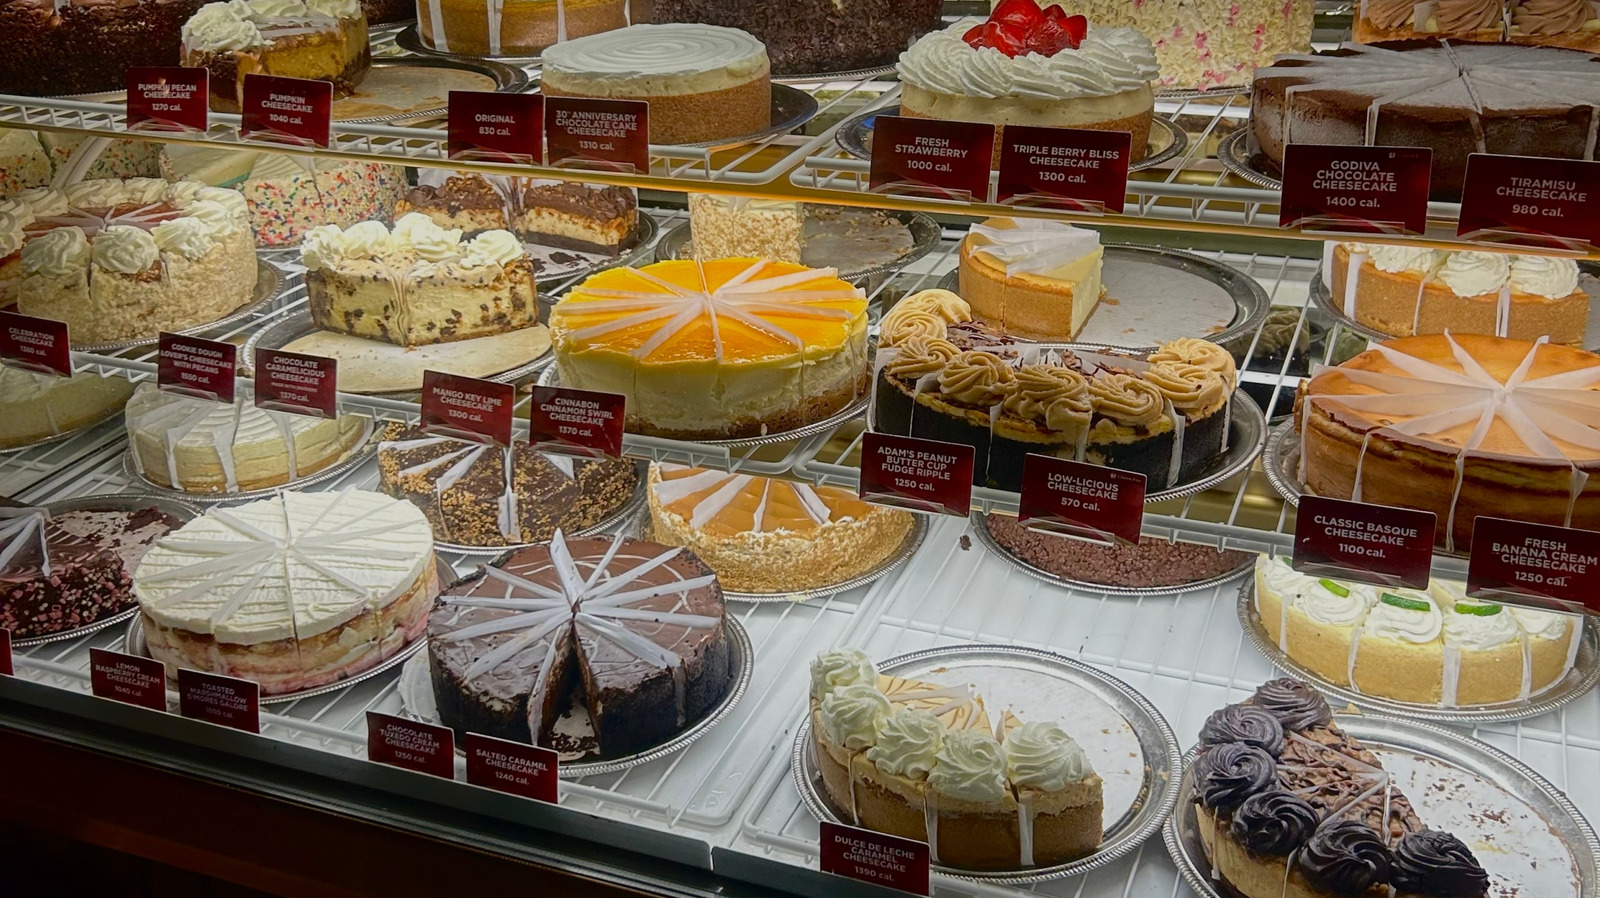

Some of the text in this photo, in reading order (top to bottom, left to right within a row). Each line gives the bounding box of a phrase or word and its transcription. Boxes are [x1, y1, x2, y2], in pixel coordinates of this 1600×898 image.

[270, 94, 305, 104] PUMPKIN
[261, 100, 312, 113] CHEESECAKE
[269, 114, 302, 124] 1040 cal.
[475, 114, 515, 123] ORIGINAL
[572, 112, 637, 122] ANNIVERSARY
[496, 127, 511, 136] cal.
[556, 119, 637, 130] CHOCOLATE CAKE
[567, 127, 627, 138] CHEESECAKE
[580, 141, 615, 151] 1310 cal.
[915, 137, 949, 147] FRESH
[895, 144, 968, 158] STRAWBERRY
[1014, 145, 1119, 160] TRIPLE BERRY BLISS
[907, 160, 952, 172] 1000 cal.
[1030, 156, 1100, 169] CHEESECAKE
[1331, 160, 1380, 171] GODIVA
[1040, 171, 1086, 183] 1300 cal.
[1317, 170, 1394, 182] CHOCOLATE
[1312, 180, 1397, 192] CHEESECAKE
[1510, 177, 1576, 190] TIRAMISU
[1496, 186, 1587, 202] CHEESECAKE
[1326, 196, 1380, 208] 1400 cal.
[1512, 204, 1564, 218] 980 cal.
[9, 327, 55, 341] CELEBRATION
[11, 334, 53, 347] CHEESECAKE
[171, 343, 222, 358] COOKIE DOUGH
[161, 350, 233, 368] LOVER'S CHEESECAKE
[274, 356, 318, 368] CHOCOLATE
[192, 364, 219, 374] PECANS
[266, 363, 325, 377] CARAMELICIOUS
[272, 372, 319, 384] CHEESECAKE
[433, 387, 502, 406] MANGO KEY LIME
[555, 398, 599, 409] CINNABON
[440, 396, 494, 412] CHEESECAKE
[448, 410, 483, 422] 1300 cal.
[540, 404, 614, 419] CINNAMON SWIRL
[550, 413, 604, 425] CHEESECAKE
[559, 426, 593, 436] 1370 cal.
[878, 446, 957, 464] ADAM'S PEANUT
[886, 456, 947, 470] BUTTER CUP
[882, 464, 950, 480] FUDGE RIPPLE
[895, 478, 935, 491] 1250 cal.
[1048, 472, 1118, 492] LOW-LICIOUS
[1048, 481, 1118, 500] CHEESECAKE
[1061, 498, 1100, 511] 570 cal.
[1314, 515, 1417, 538] CLASSIC BASQUE
[1325, 527, 1404, 546] CHEESECAKE
[1339, 544, 1386, 558] 1100 cal.
[1525, 538, 1566, 551] FRESH
[1492, 543, 1598, 566] BANANA CREAM
[1502, 554, 1586, 574] CHEESECAKE
[1515, 571, 1567, 587] 1250 cal.
[116, 662, 140, 672] LEMON
[96, 665, 160, 684] RASPBERRY CREAM
[107, 674, 150, 688] CHEESECAKE
[115, 685, 130, 694] 1040
[190, 688, 247, 704] MARSHMALLOW
[202, 683, 235, 695] TOASTED
[187, 693, 248, 711] S'MORES GALORE
[380, 729, 439, 749] TUXEDO CREAM
[387, 724, 433, 740] CHOCOLATE
[385, 738, 435, 755] CHEESECAKE
[395, 751, 412, 760] 1250
[476, 749, 548, 771] SALTED CARAMEL
[486, 758, 538, 776] CHEESECAKE
[495, 771, 529, 785] 1240 cal.
[835, 835, 915, 859] DULCE DE LECHE
[843, 852, 906, 872] CHEESECAKE
[851, 847, 898, 863] CARAMEL
[854, 866, 894, 881] 1390 cal.
